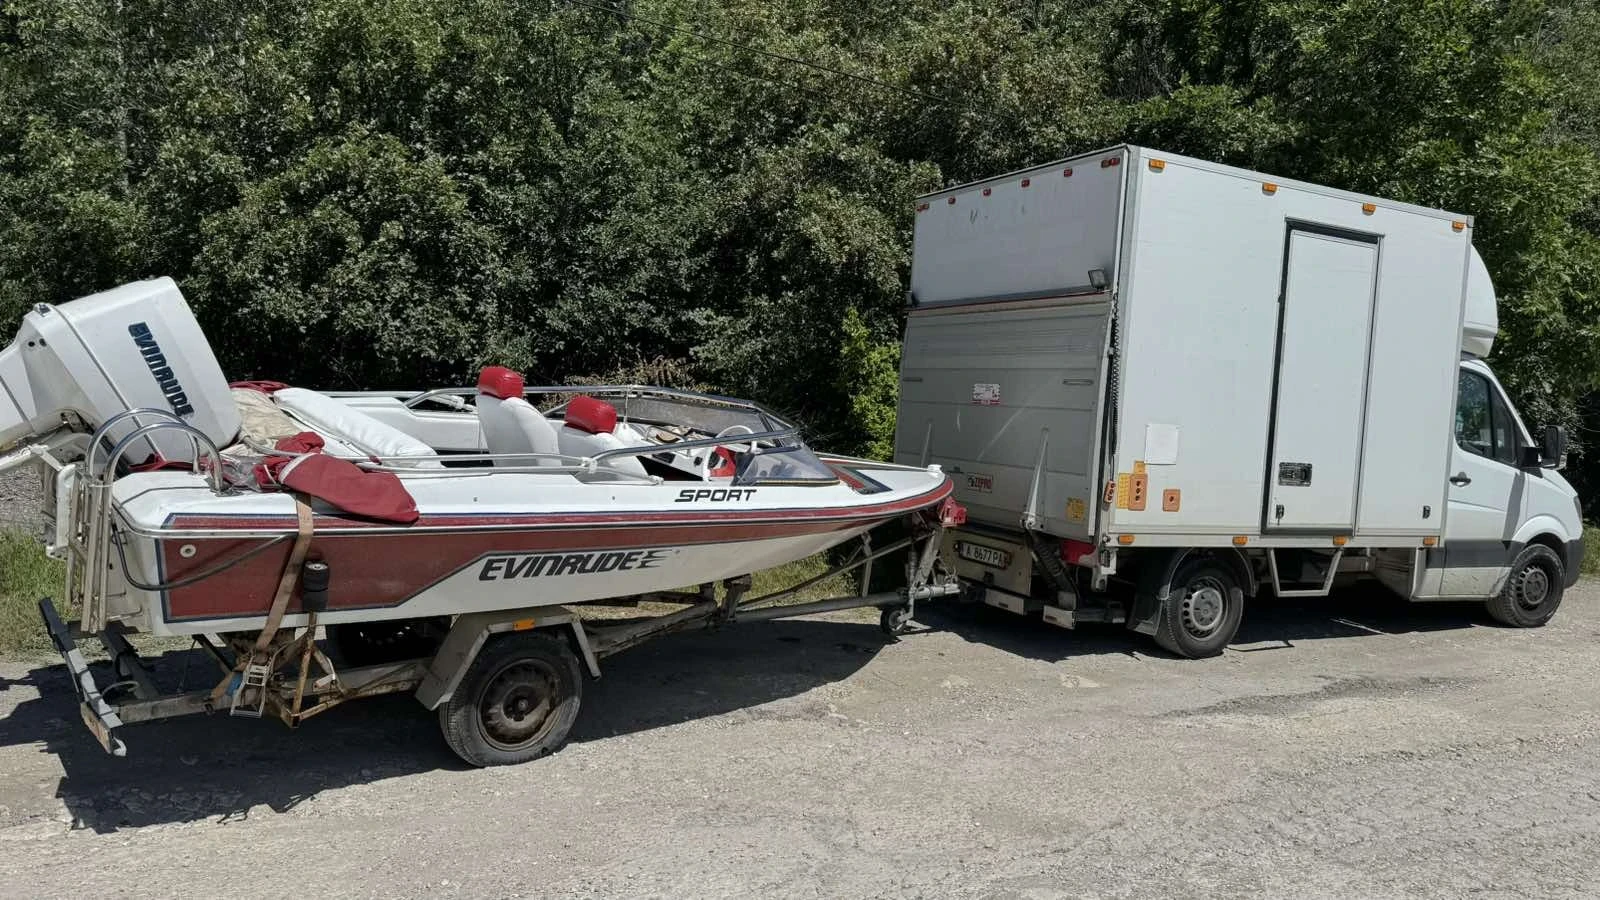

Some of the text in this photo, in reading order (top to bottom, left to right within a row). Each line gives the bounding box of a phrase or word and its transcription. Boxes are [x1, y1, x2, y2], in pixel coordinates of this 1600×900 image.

[128, 322, 194, 417] EVINRUDE
[675, 489, 757, 502] SPORT
[478, 551, 644, 581] EVINRUDE
